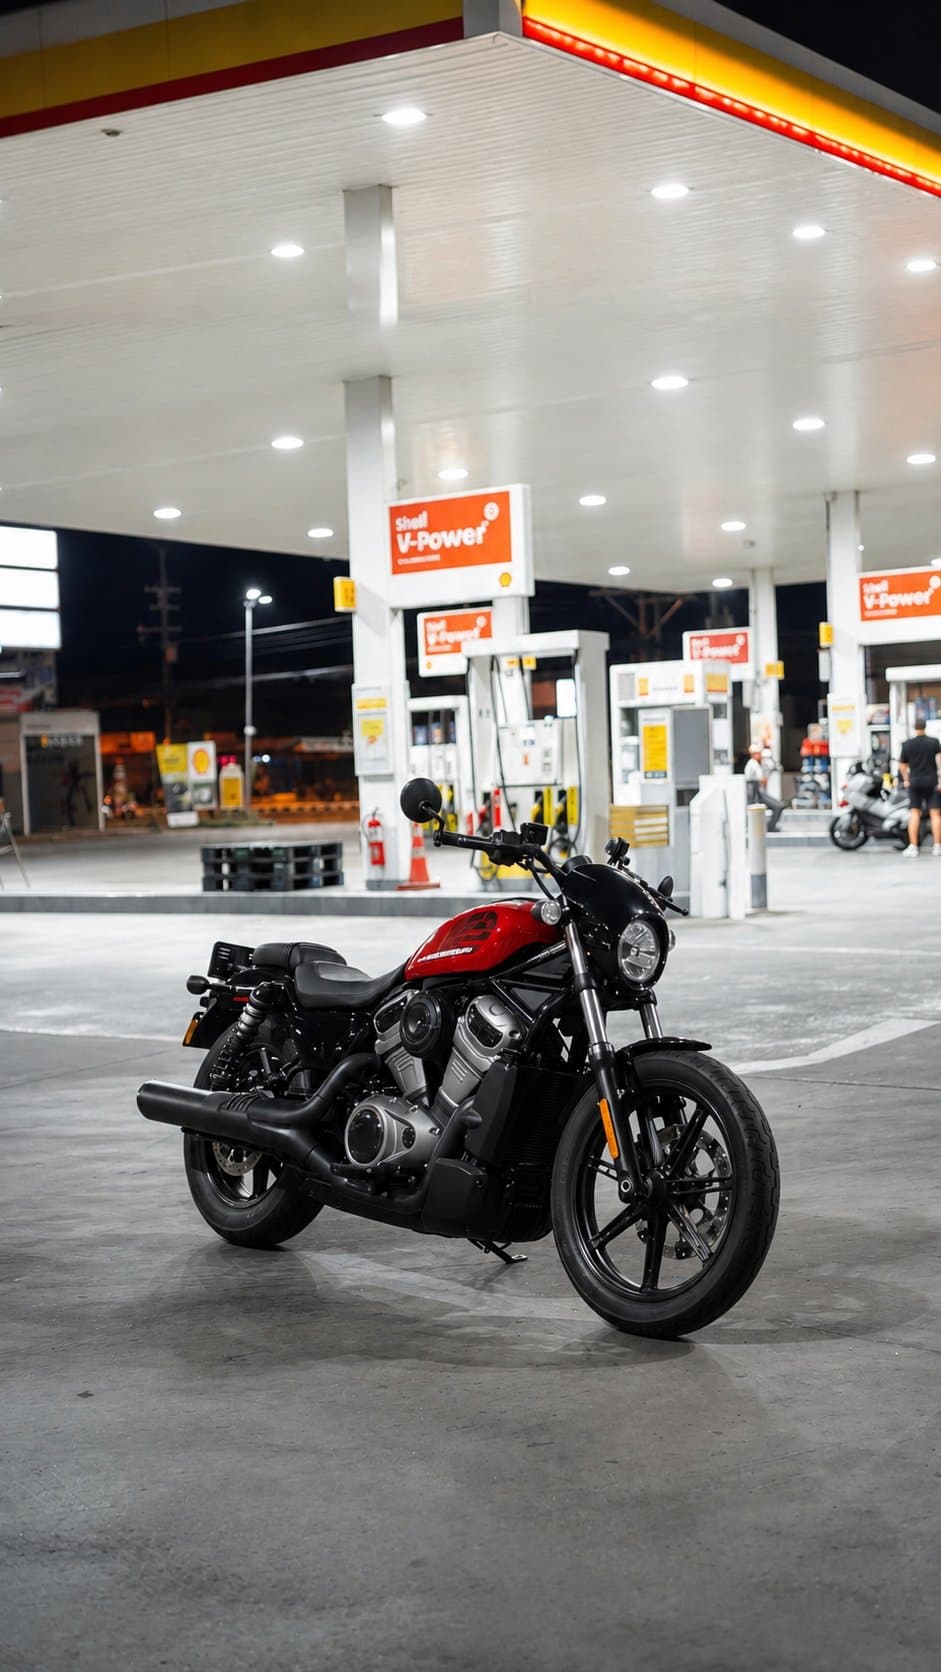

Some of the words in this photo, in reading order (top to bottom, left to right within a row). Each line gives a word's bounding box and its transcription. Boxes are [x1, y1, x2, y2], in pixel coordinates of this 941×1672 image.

[395, 510, 428, 531] Shell
[396, 527, 486, 554] V-Power
[863, 590, 932, 610] V-Power
